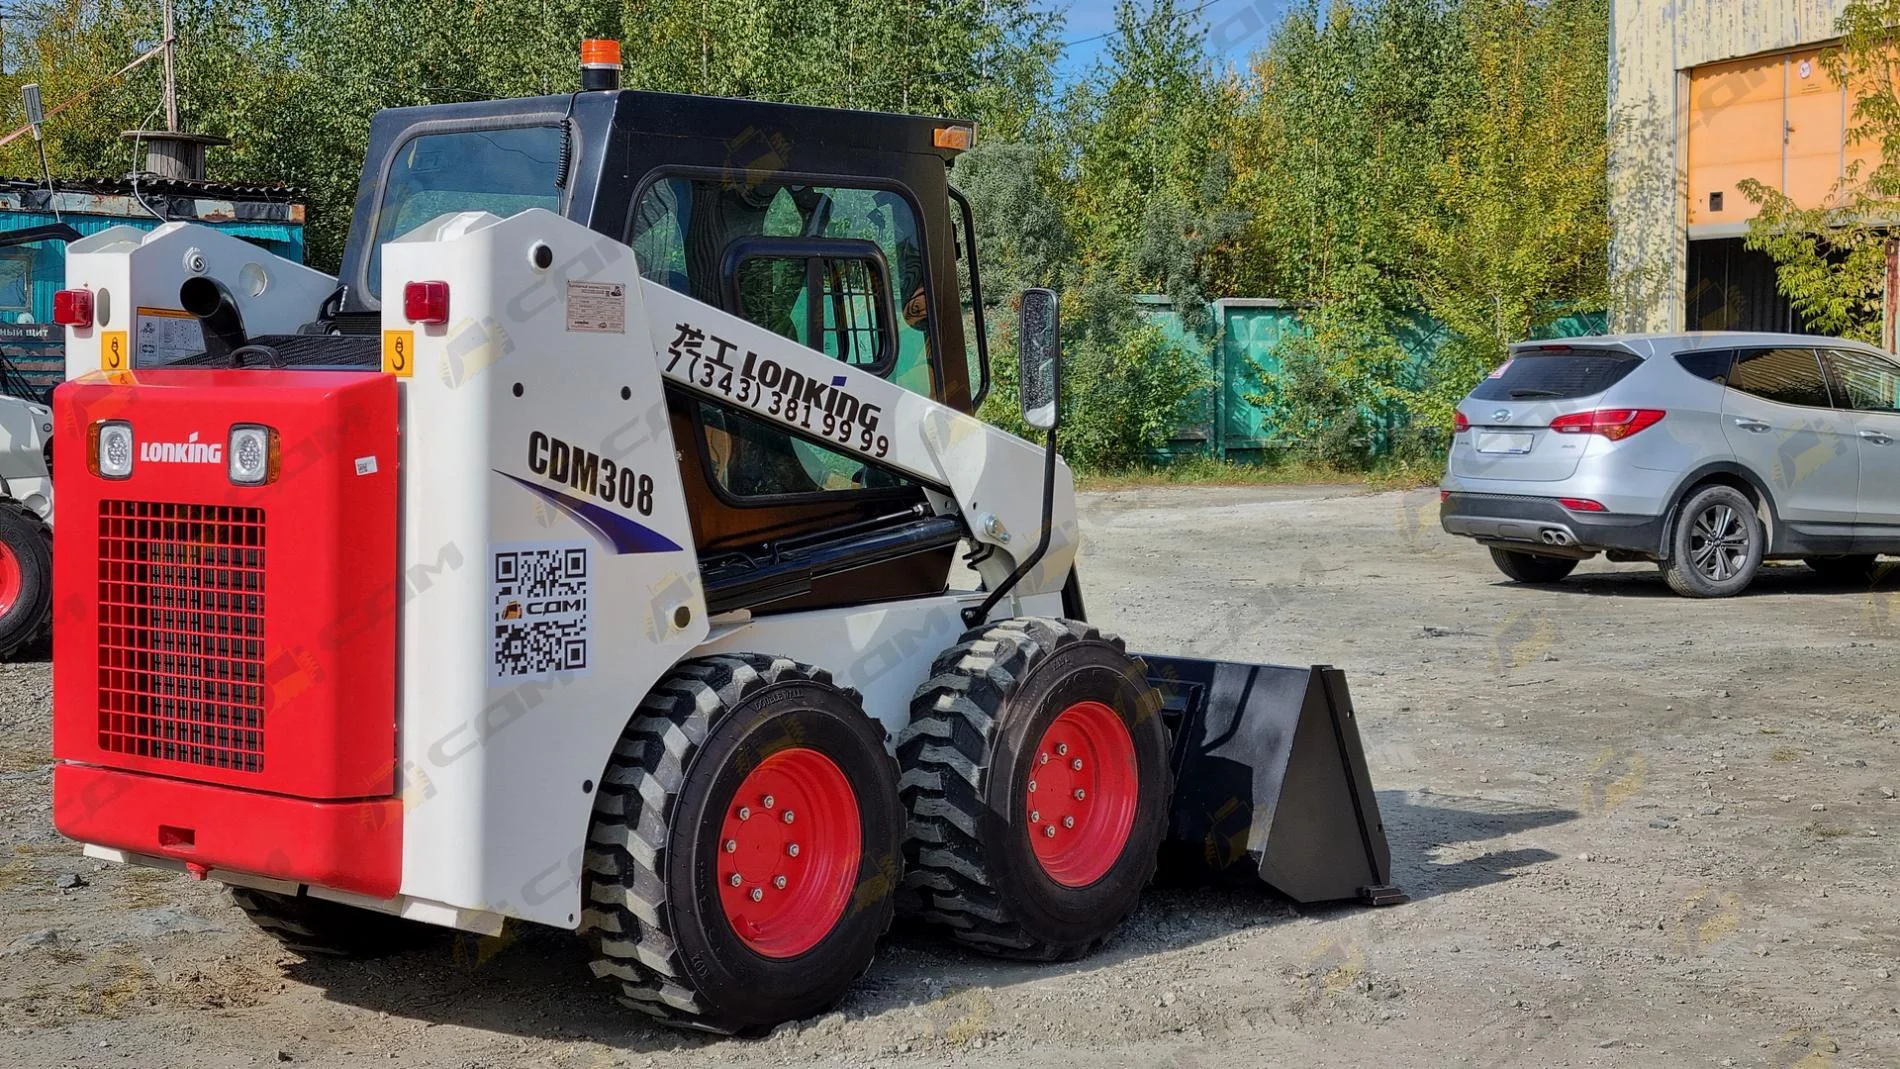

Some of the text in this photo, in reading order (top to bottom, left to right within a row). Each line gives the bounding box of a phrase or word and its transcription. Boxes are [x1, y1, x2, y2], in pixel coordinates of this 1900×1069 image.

[768, 391, 811, 429] 381
[140, 431, 222, 464] LONKING
[528, 430, 654, 516] CDM308
